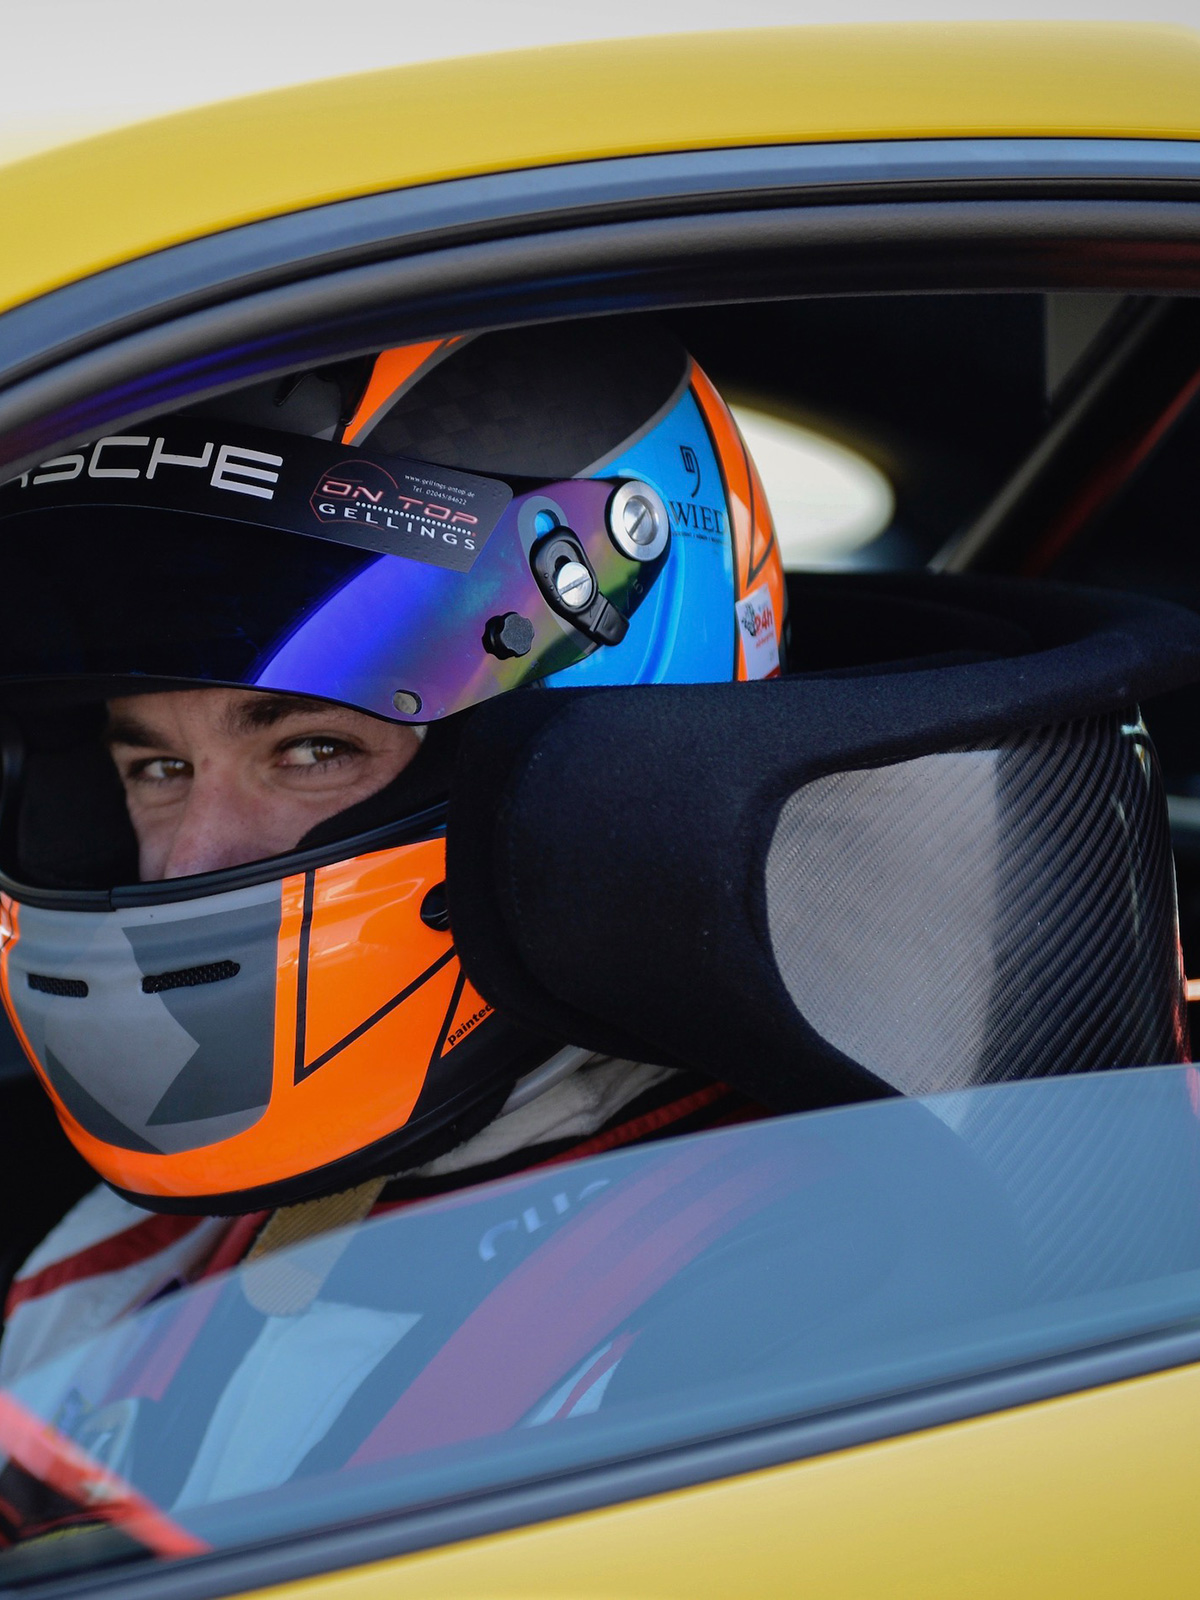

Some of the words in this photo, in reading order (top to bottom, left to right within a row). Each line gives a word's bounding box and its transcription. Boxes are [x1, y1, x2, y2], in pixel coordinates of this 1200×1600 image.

[322, 480, 384, 503] ON
[398, 495, 479, 525] TOP
[318, 503, 476, 550] GELLINGS
